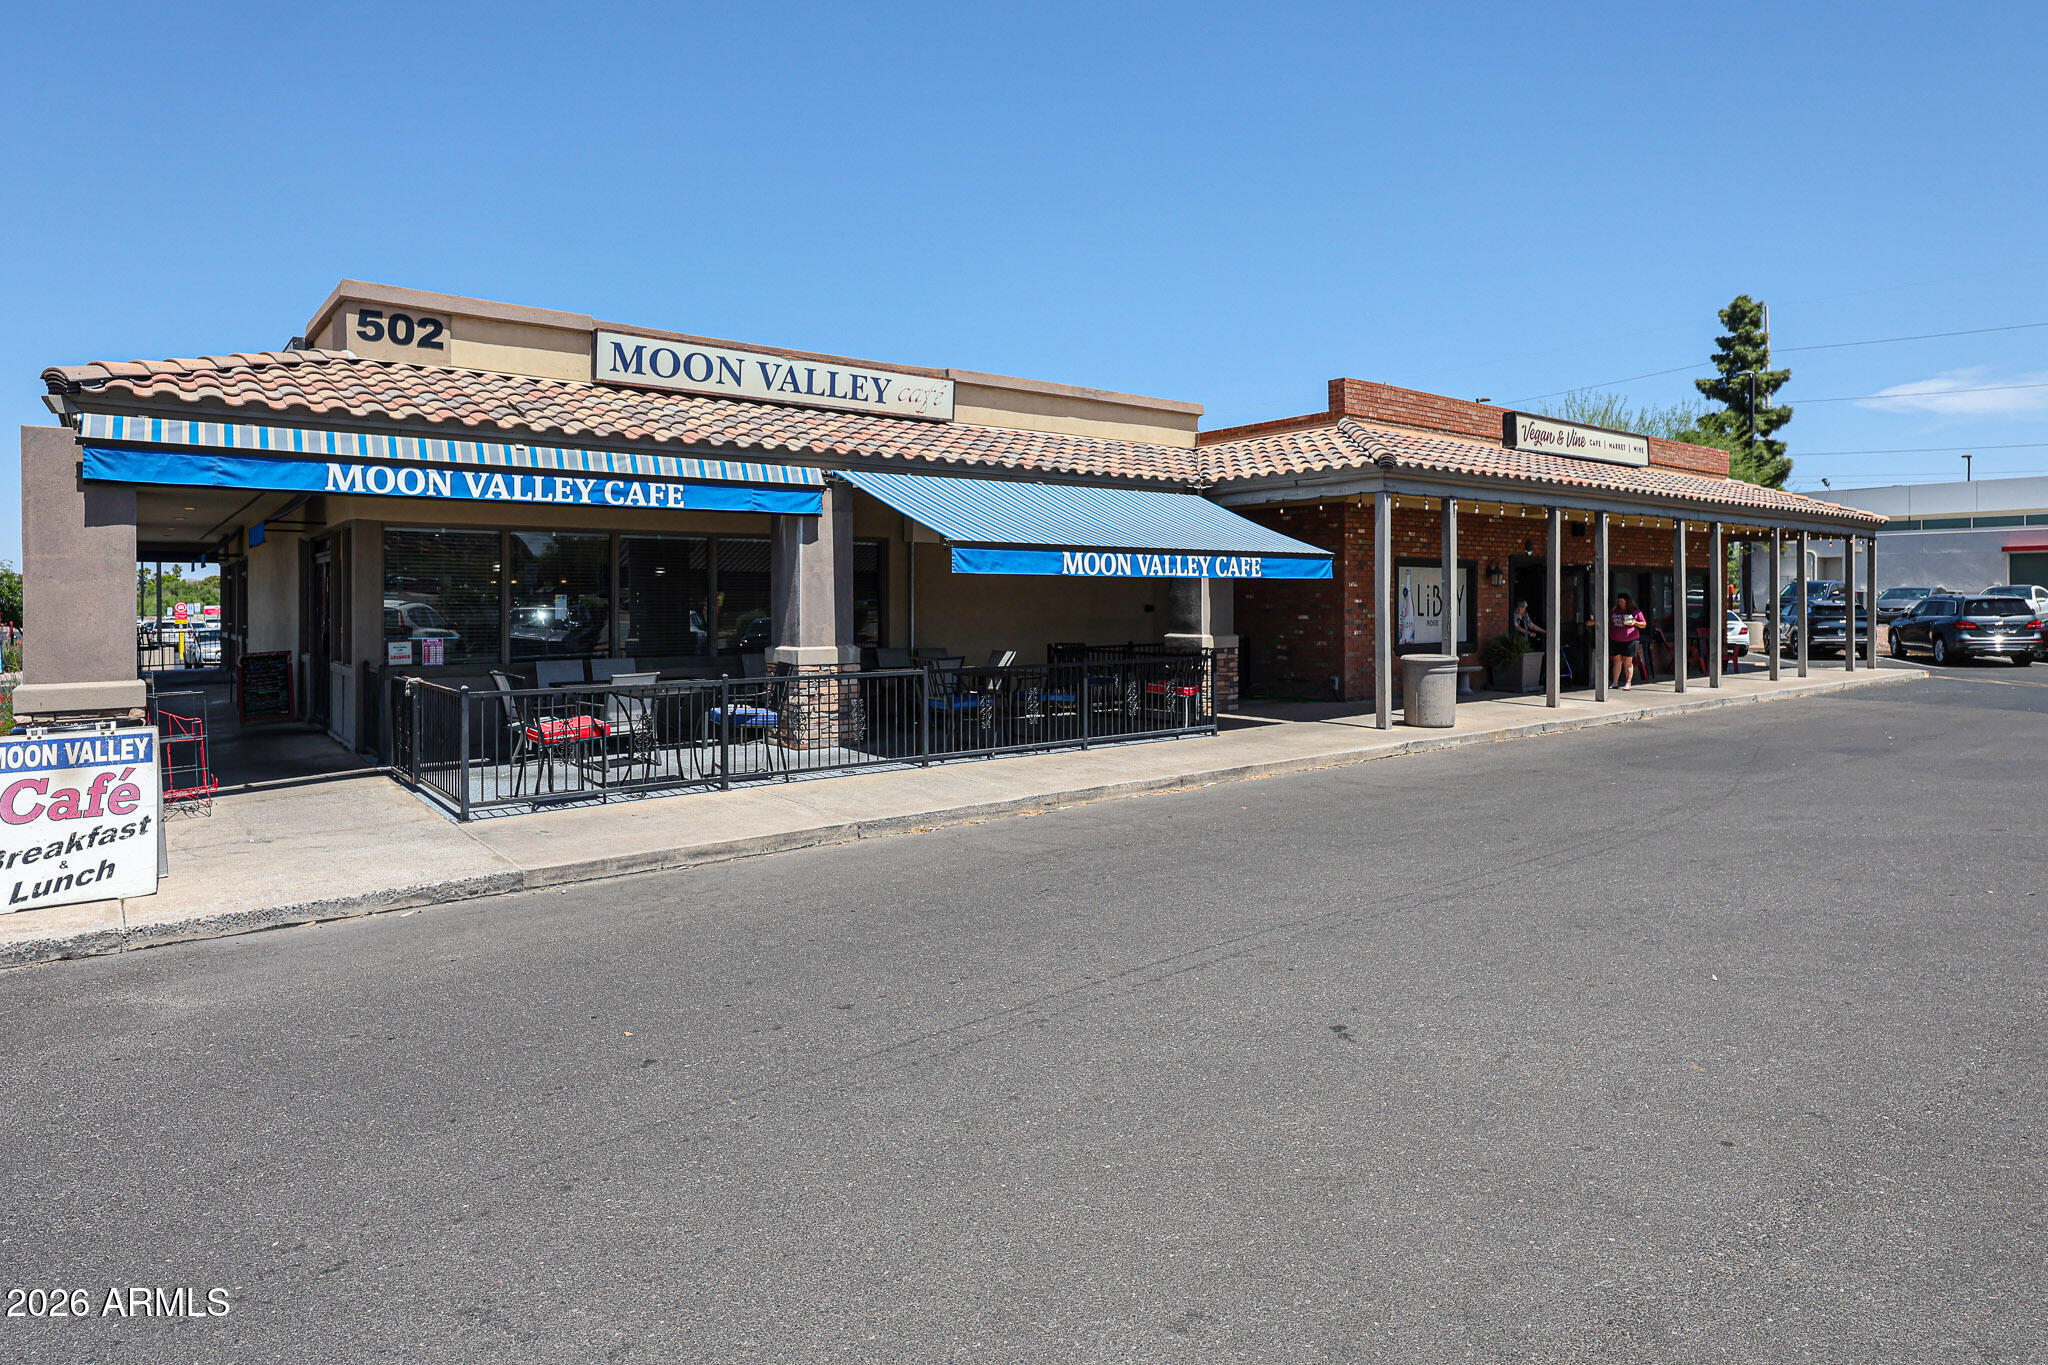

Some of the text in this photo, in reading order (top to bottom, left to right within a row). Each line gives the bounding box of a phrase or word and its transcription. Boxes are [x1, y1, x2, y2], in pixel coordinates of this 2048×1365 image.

[357, 309, 444, 351] 502
[609, 341, 746, 388] MOON
[756, 361, 892, 404] VALLEY
[1521, 421, 1555, 447] Vegan
[1556, 430, 1565, 445] &
[1566, 428, 1587, 448] Vine
[324, 463, 685, 508] MOON VALLEY CAFE
[1062, 551, 1262, 577] MOON VALLEY CAFE
[1417, 584, 1465, 617] LiBY
[65, 737, 149, 765] VALLEY
[0, 767, 141, 825] Café
[8, 859, 116, 905] Lunch
[59, 860, 68, 869] &
